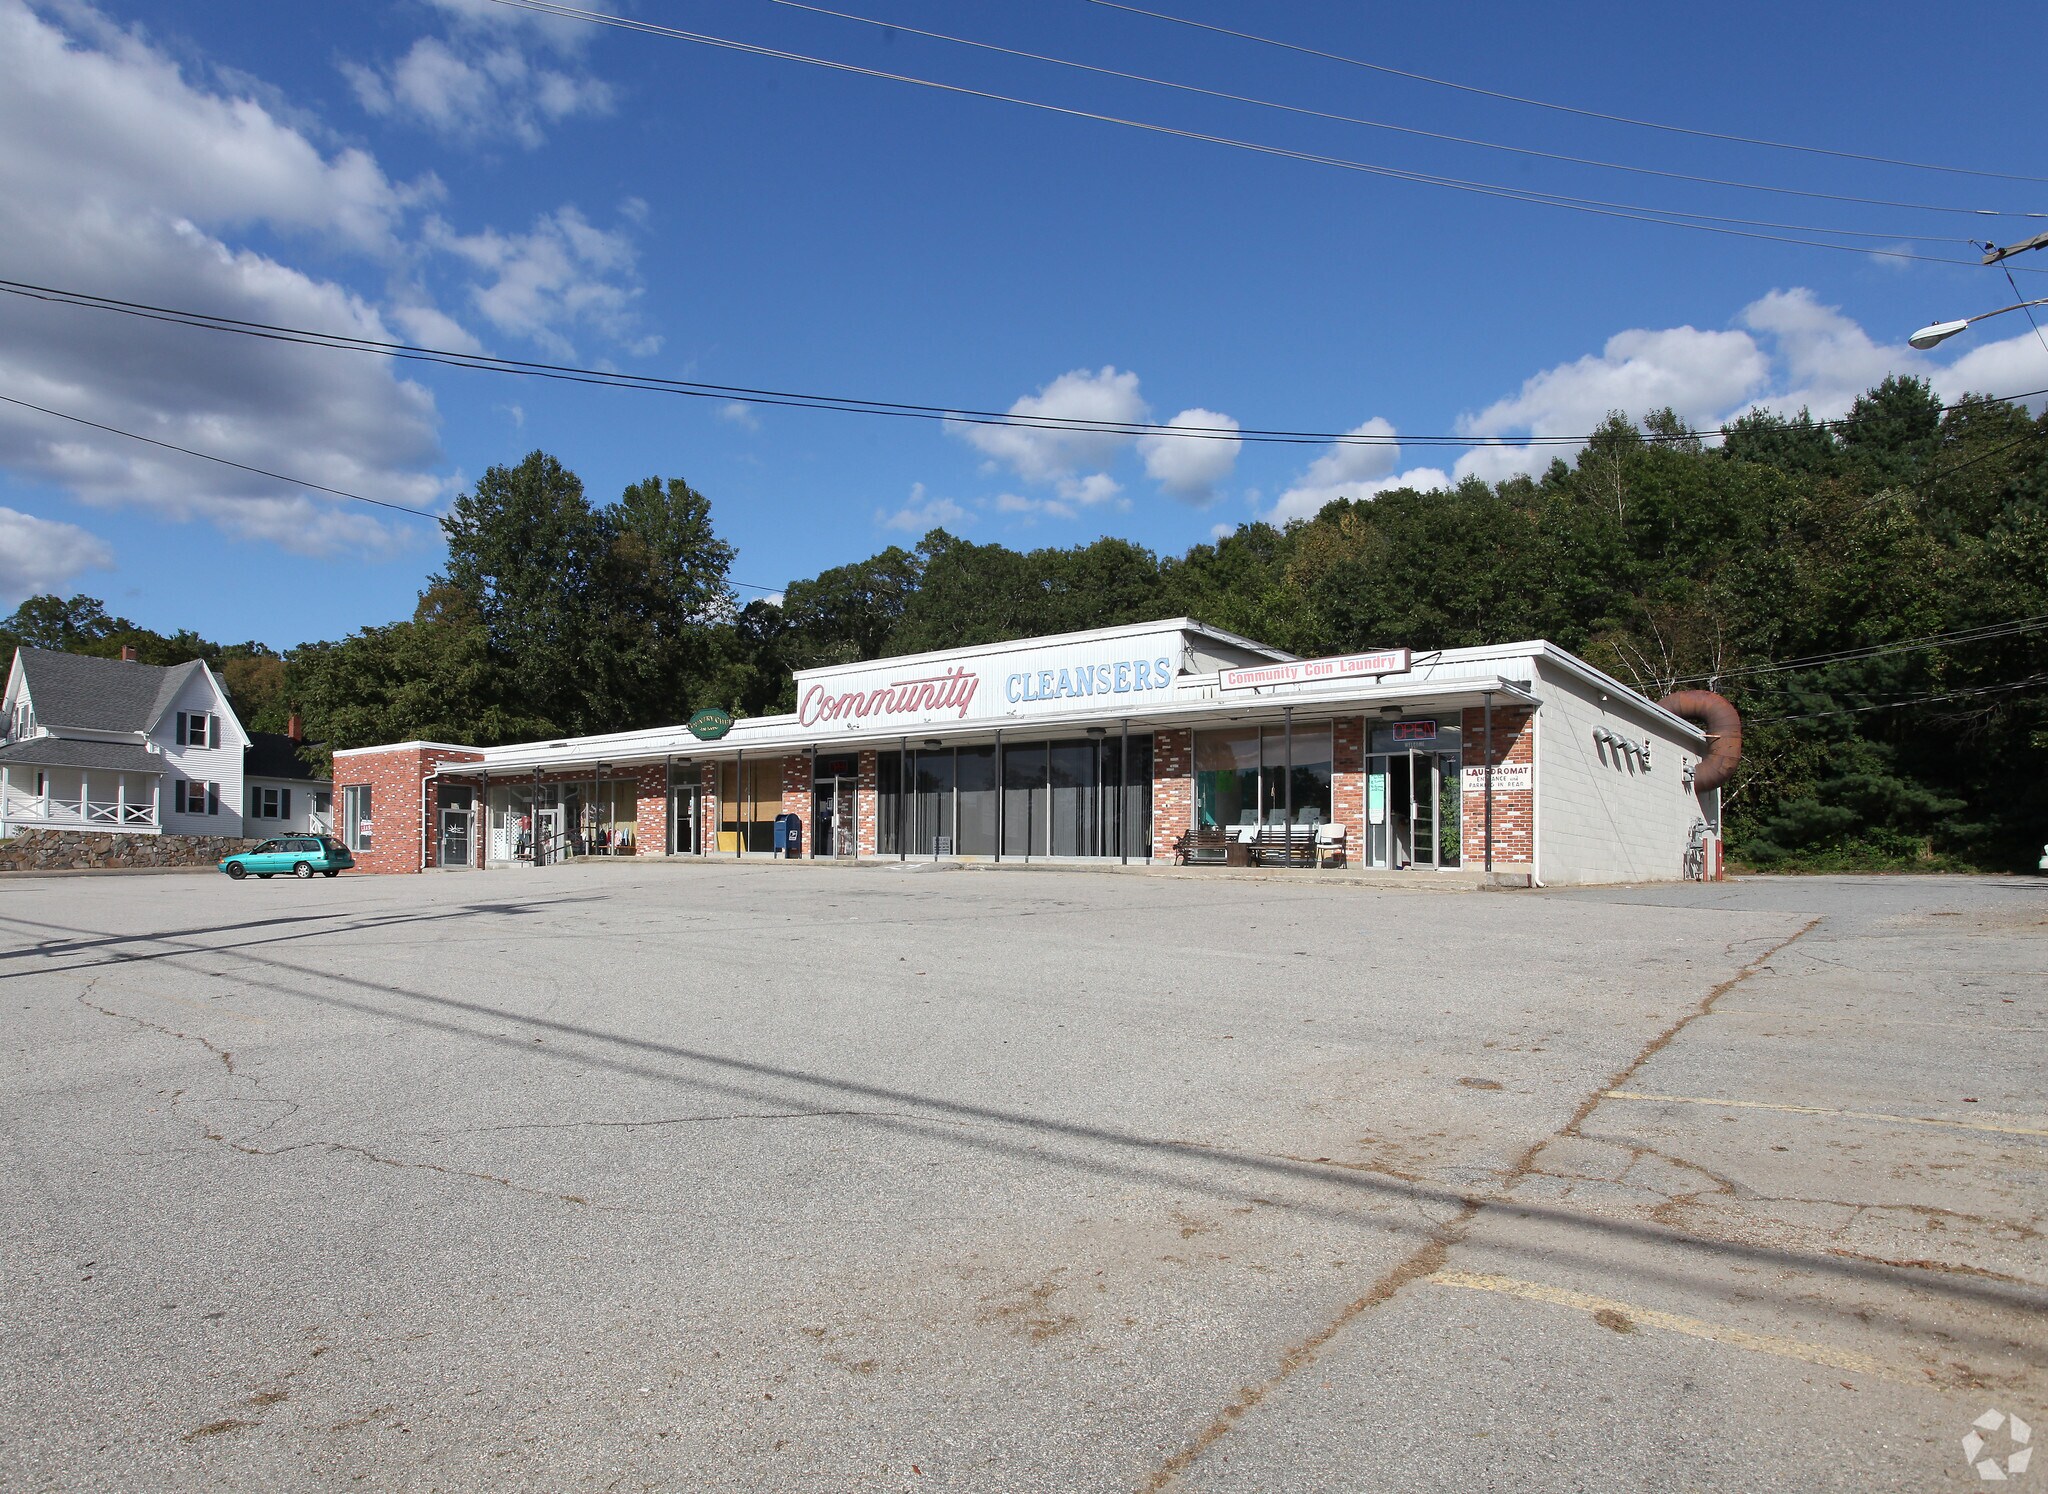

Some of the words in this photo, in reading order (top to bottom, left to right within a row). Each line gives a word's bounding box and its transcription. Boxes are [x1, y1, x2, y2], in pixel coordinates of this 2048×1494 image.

[1228, 666, 1298, 685] Community
[1304, 662, 1334, 676] Coin
[1340, 656, 1396, 672] Laundry
[800, 666, 980, 727] Community
[1005, 657, 1171, 703] CLEANSERS
[1394, 722, 1435, 740] OPEN
[1466, 766, 1529, 777] LAUDROMAT
